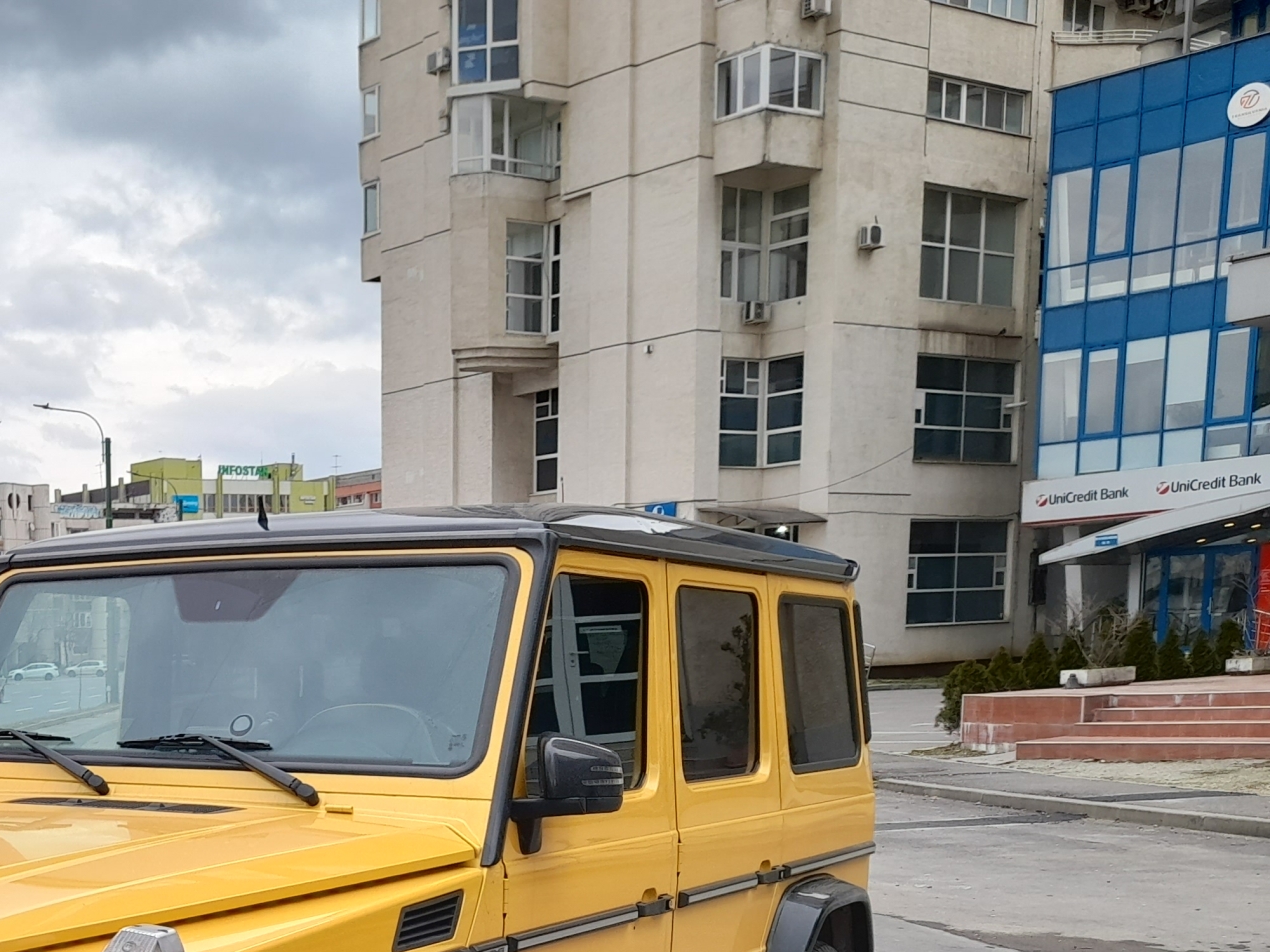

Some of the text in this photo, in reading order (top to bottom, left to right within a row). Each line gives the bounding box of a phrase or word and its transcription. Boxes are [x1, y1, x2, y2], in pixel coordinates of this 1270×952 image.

[1171, 473, 1261, 494] UniCredit Bank
[1048, 486, 1129, 506] UniCredit Bank
